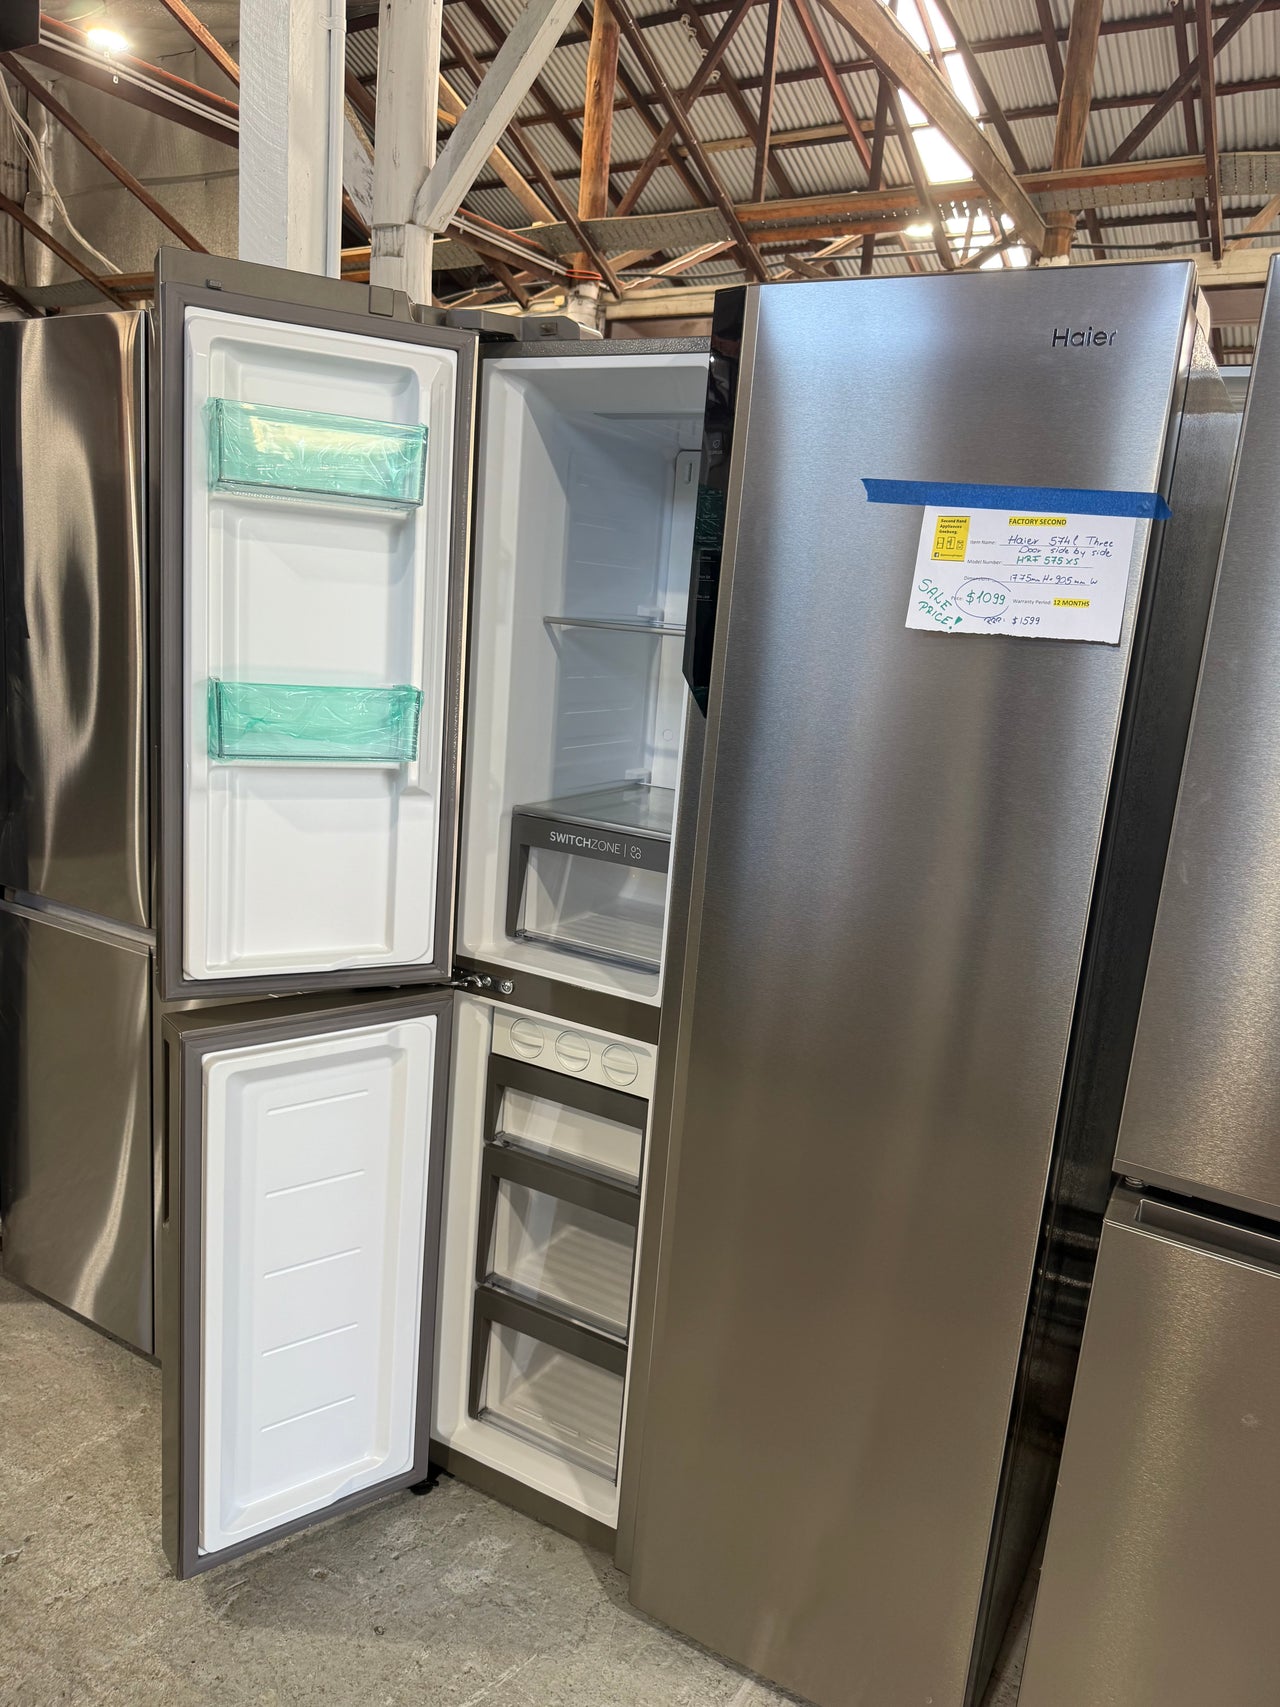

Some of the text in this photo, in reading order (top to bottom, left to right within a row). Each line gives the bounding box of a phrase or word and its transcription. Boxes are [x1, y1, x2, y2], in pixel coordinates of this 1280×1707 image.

[1052, 326, 1117, 347] Haier
[1040, 518, 1067, 526] SECOND
[1008, 534, 1039, 545] Haier
[1086, 536, 1114, 547] Three
[1018, 545, 1112, 558] Door side by side
[918, 578, 952, 611] SALE
[966, 589, 1006, 605] $1099
[918, 601, 963, 630] PRICE!
[1011, 616, 1040, 625] $1599
[549, 831, 621, 854] SWITCHZONE
